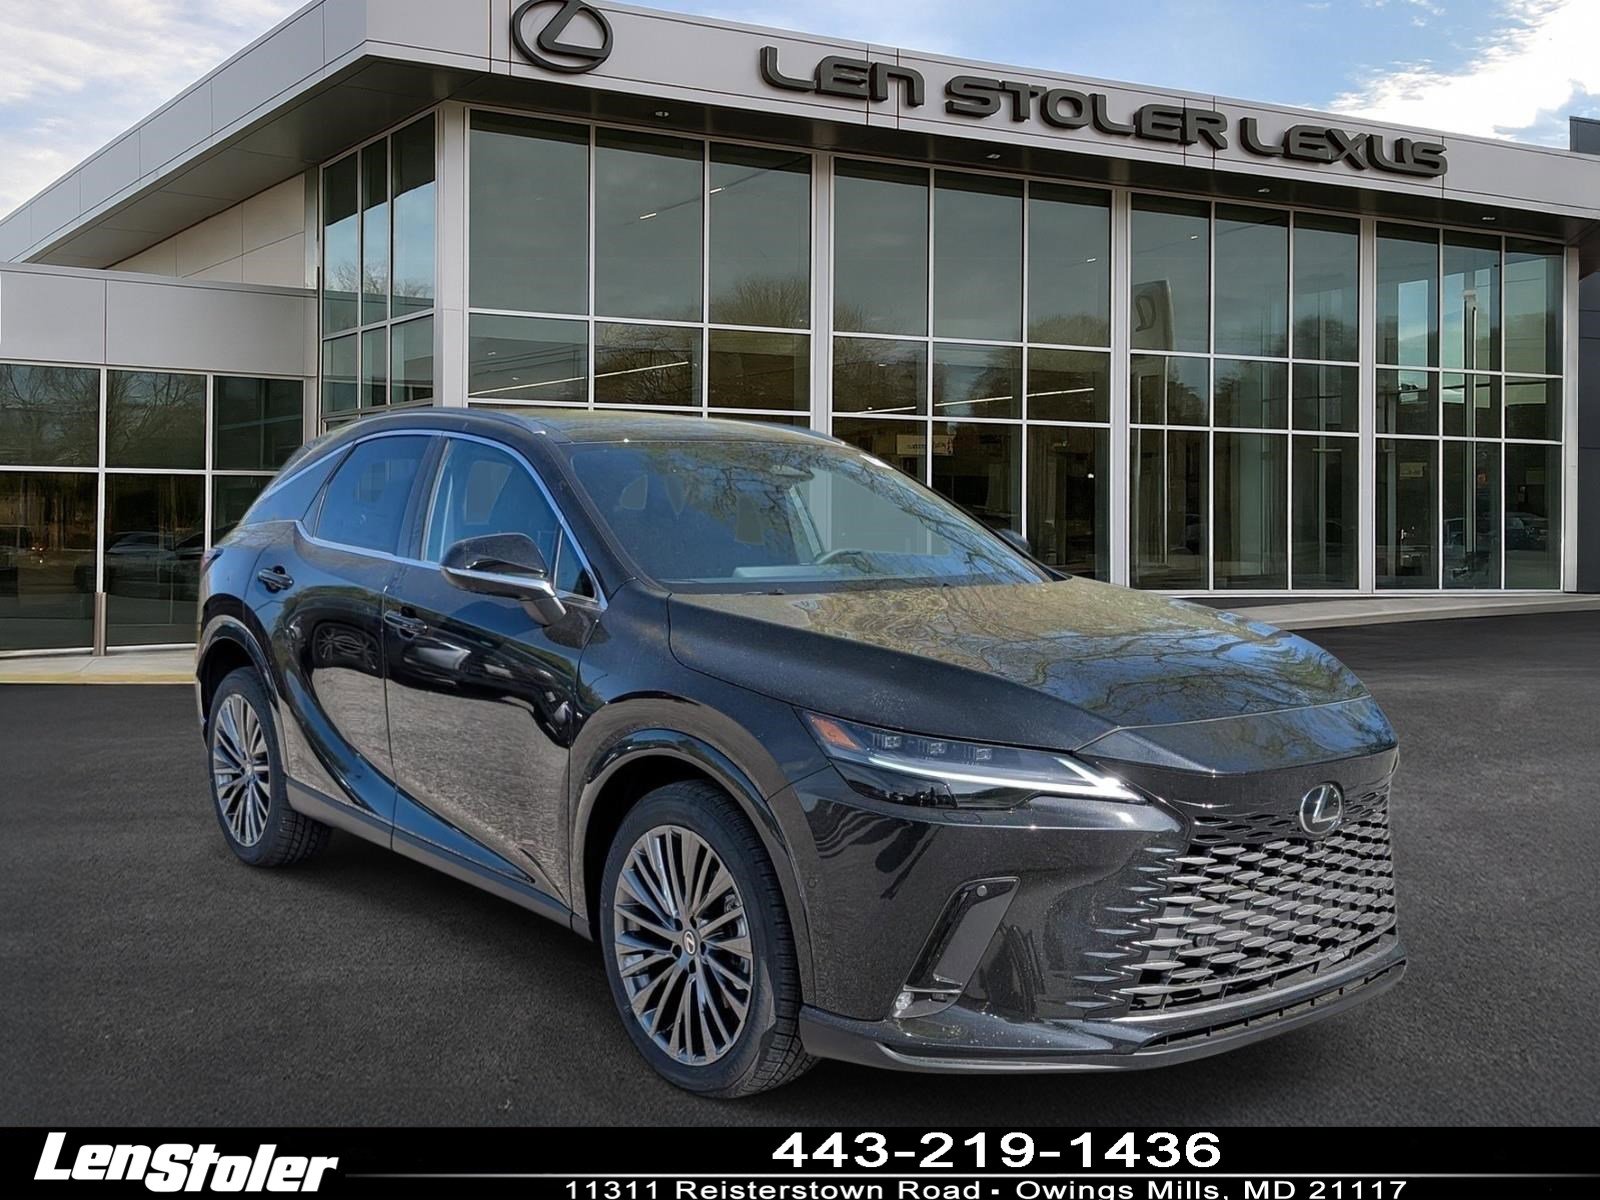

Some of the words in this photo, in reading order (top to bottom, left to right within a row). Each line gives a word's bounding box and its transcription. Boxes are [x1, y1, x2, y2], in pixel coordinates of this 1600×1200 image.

[760, 46, 925, 106] LEN
[945, 75, 1228, 150] STOLER
[1240, 117, 1448, 177] LEXUS
